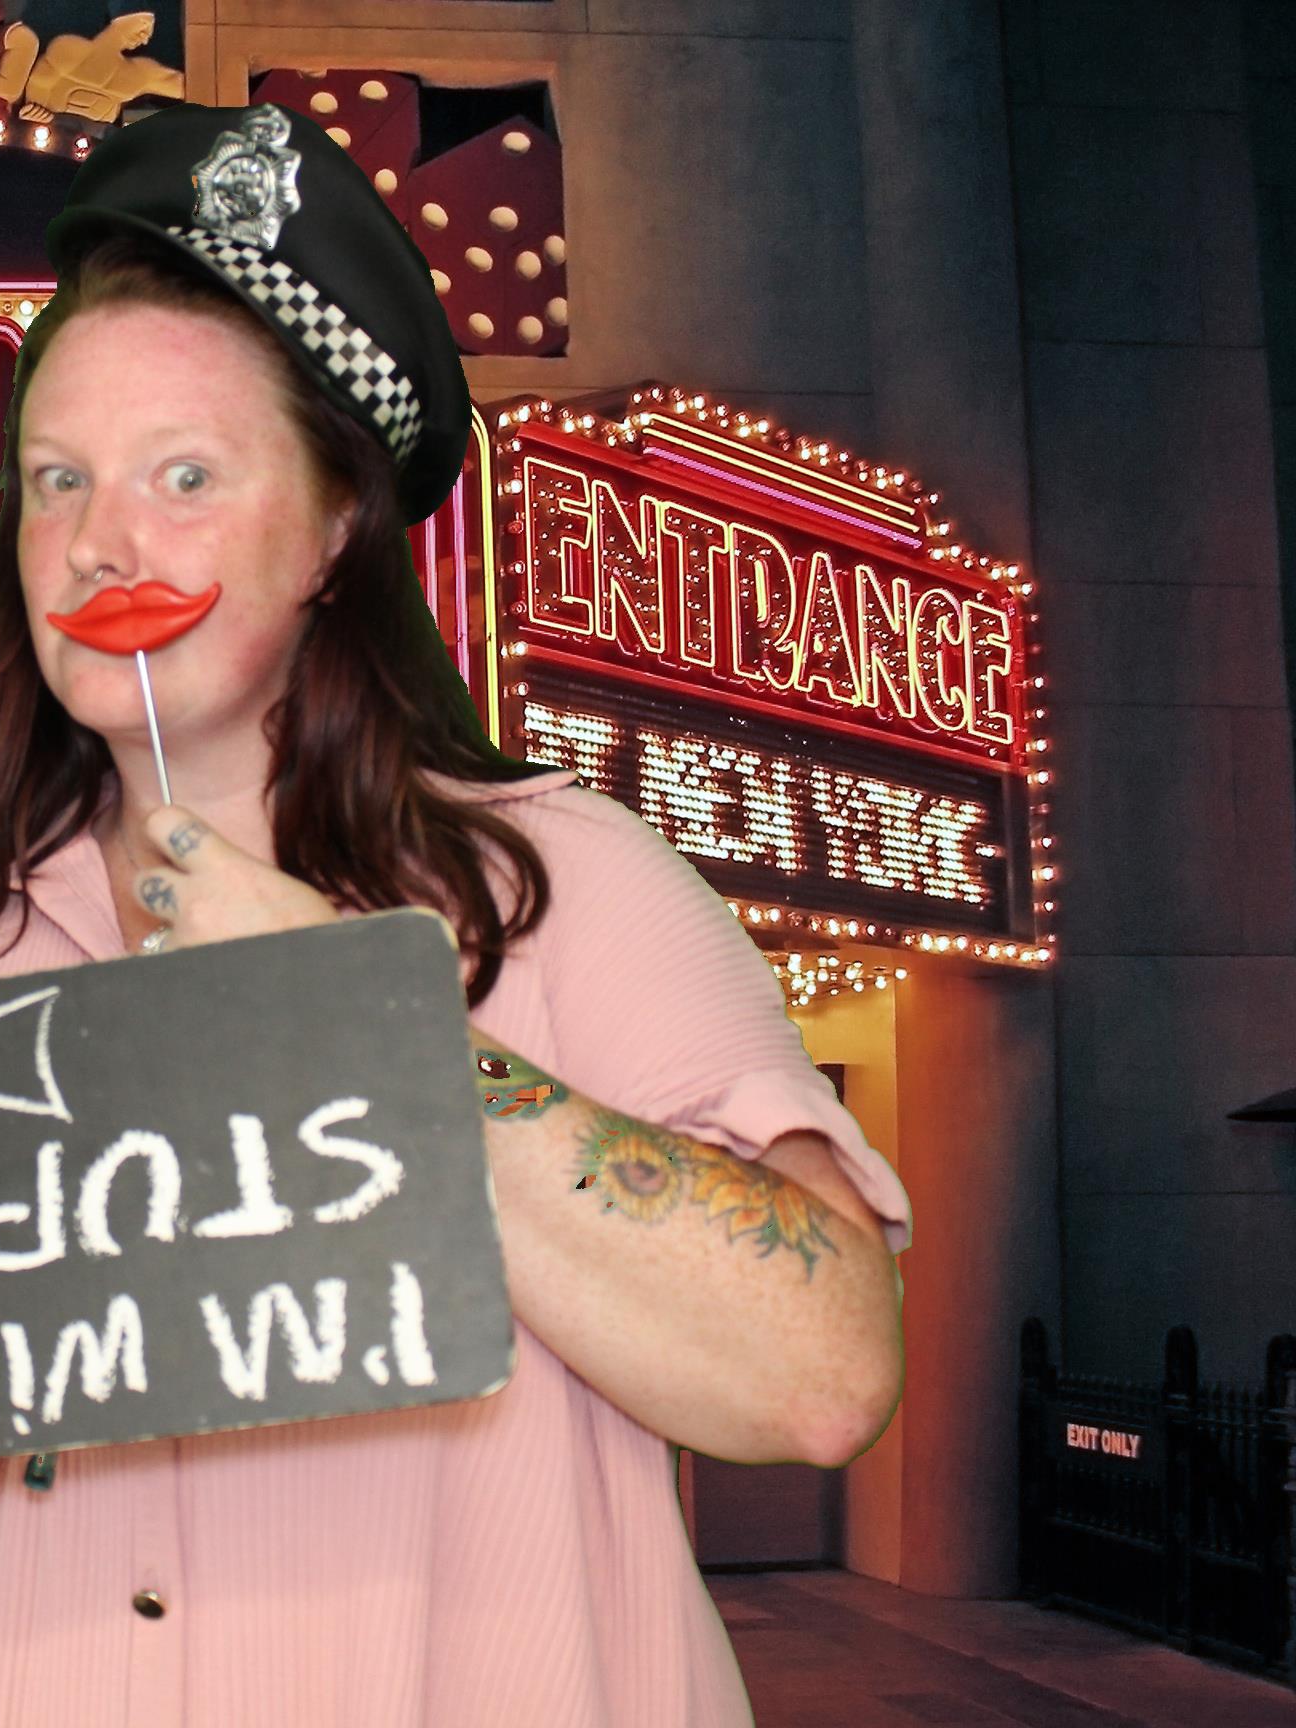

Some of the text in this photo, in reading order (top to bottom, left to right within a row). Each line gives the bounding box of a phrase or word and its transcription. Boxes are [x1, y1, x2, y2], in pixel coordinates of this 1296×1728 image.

[522, 456, 1015, 745] ENTRANCE
[200, 1260, 437, 1401] I'M
[1066, 1422, 1141, 1458] EXIT ONLY
